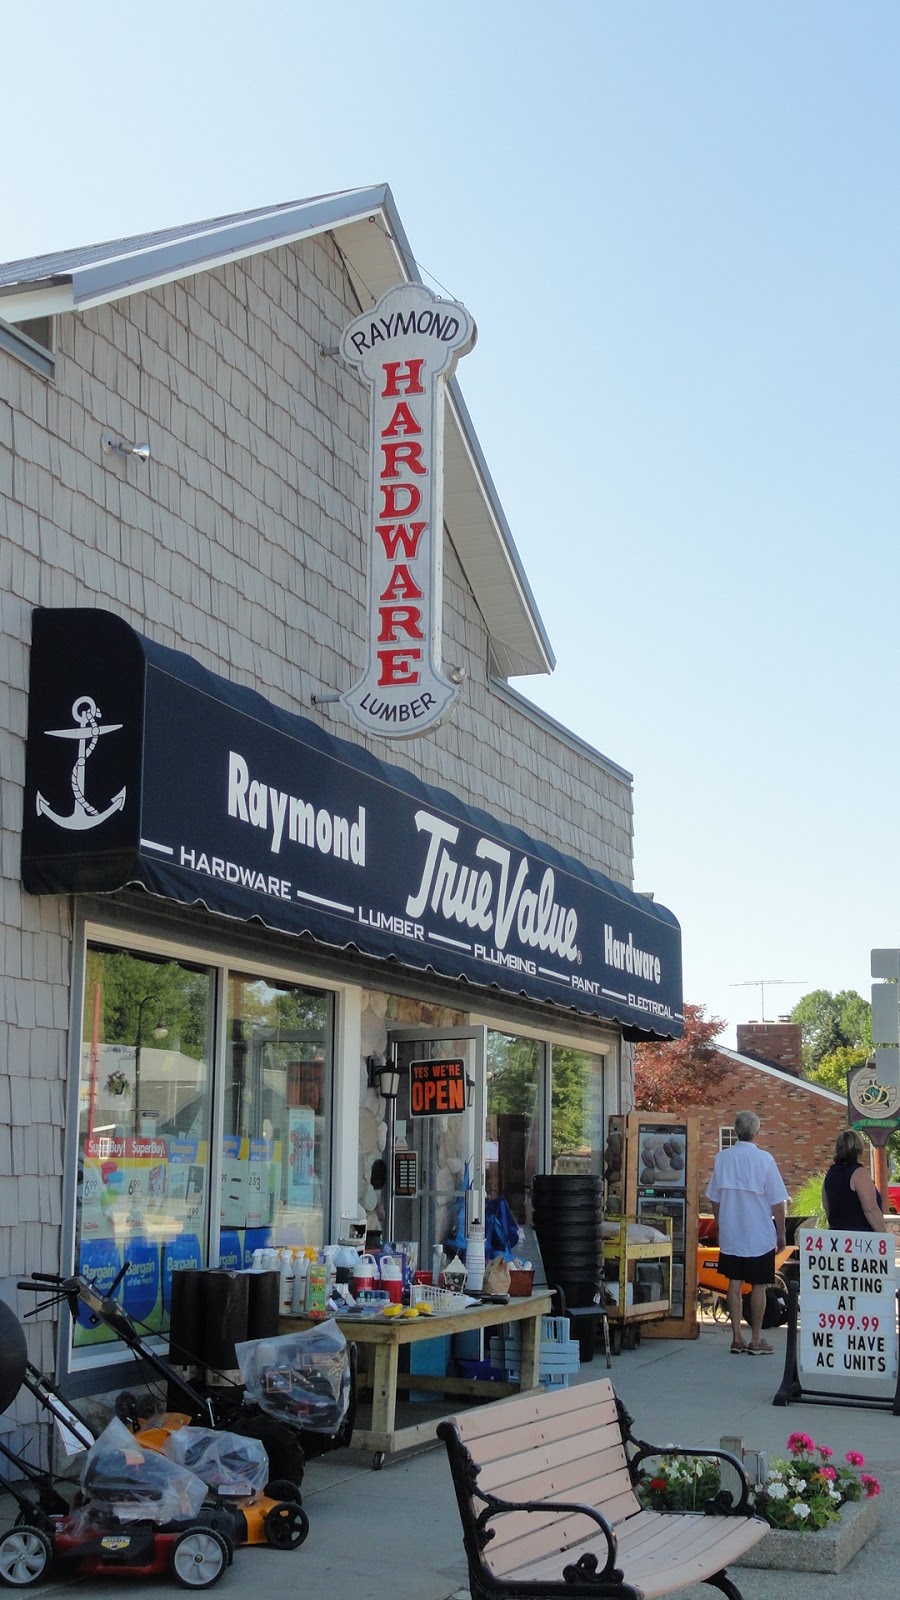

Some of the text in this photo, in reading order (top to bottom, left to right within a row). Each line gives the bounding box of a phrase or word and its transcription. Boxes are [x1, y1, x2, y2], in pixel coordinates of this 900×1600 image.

[351, 311, 459, 354] RAYMOND
[375, 358, 428, 687] HARDWARE
[360, 692, 437, 722] LUMBER
[228, 751, 366, 867] Raymond
[180, 846, 674, 1020] HARDWARE LUMBER PLUMBING PAINT ELECTRICAL
[604, 923, 661, 985] Hardware
[414, 1064, 461, 1079] YES WE'RE
[412, 1079, 464, 1112] OPEN
[805, 1236, 823, 1252] 24
[830, 1238, 838, 1253] X
[878, 1240, 887, 1255] 8
[808, 1255, 888, 1275] POLE BARN
[812, 1274, 882, 1294] STARTING
[838, 1295, 856, 1311] AT
[818, 1313, 879, 1332] 3999.99
[812, 1332, 885, 1352] WE HAVE
[816, 1352, 886, 1372] AC UNITS
